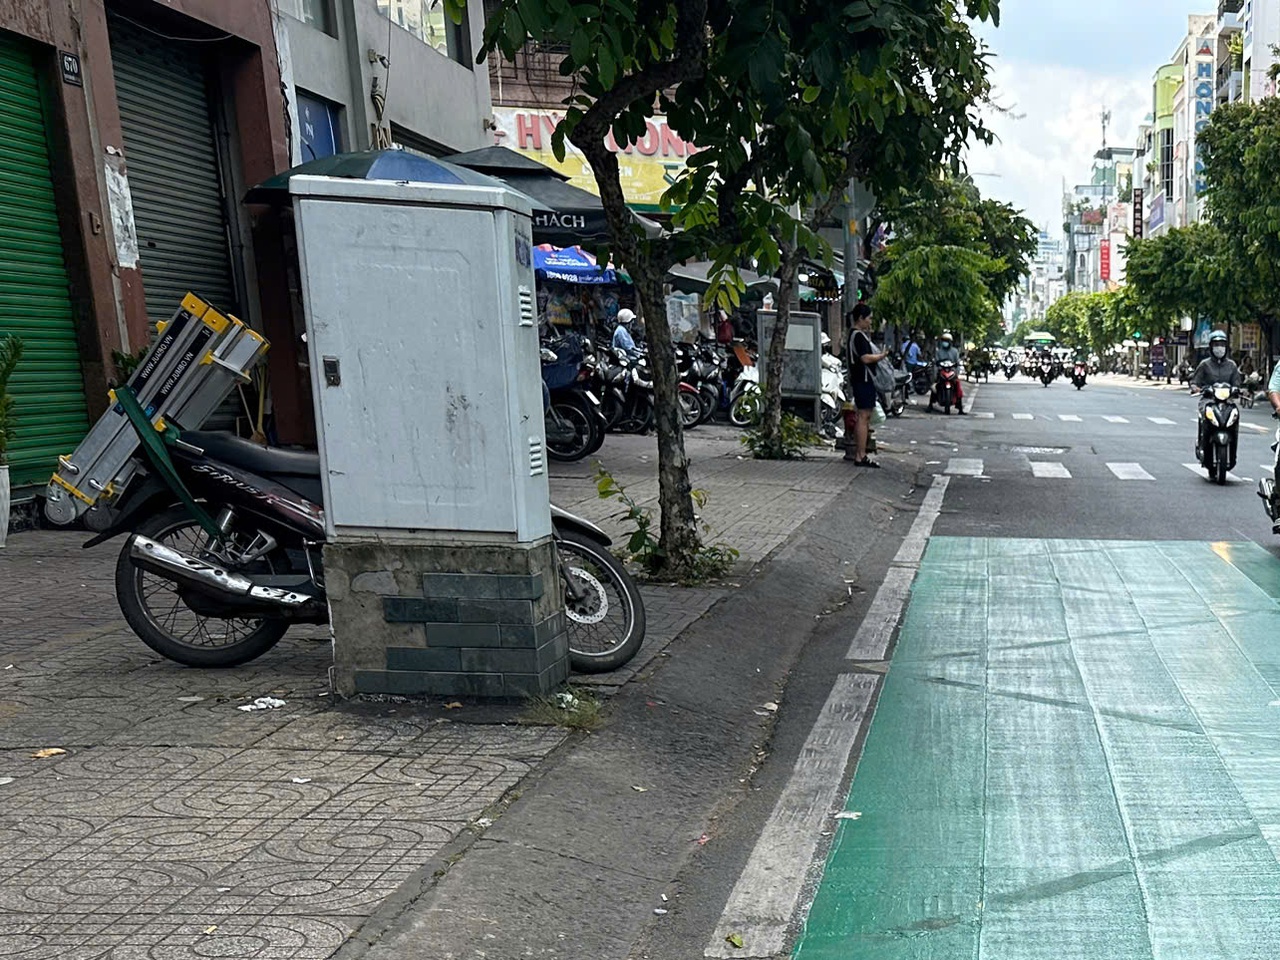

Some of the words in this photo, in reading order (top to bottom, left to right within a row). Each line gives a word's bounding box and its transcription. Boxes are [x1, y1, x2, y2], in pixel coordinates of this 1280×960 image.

[64, 55, 78, 74] 670
[532, 211, 585, 228] HÁCH
[160, 351, 194, 395] WWW.JUMBO.VN
